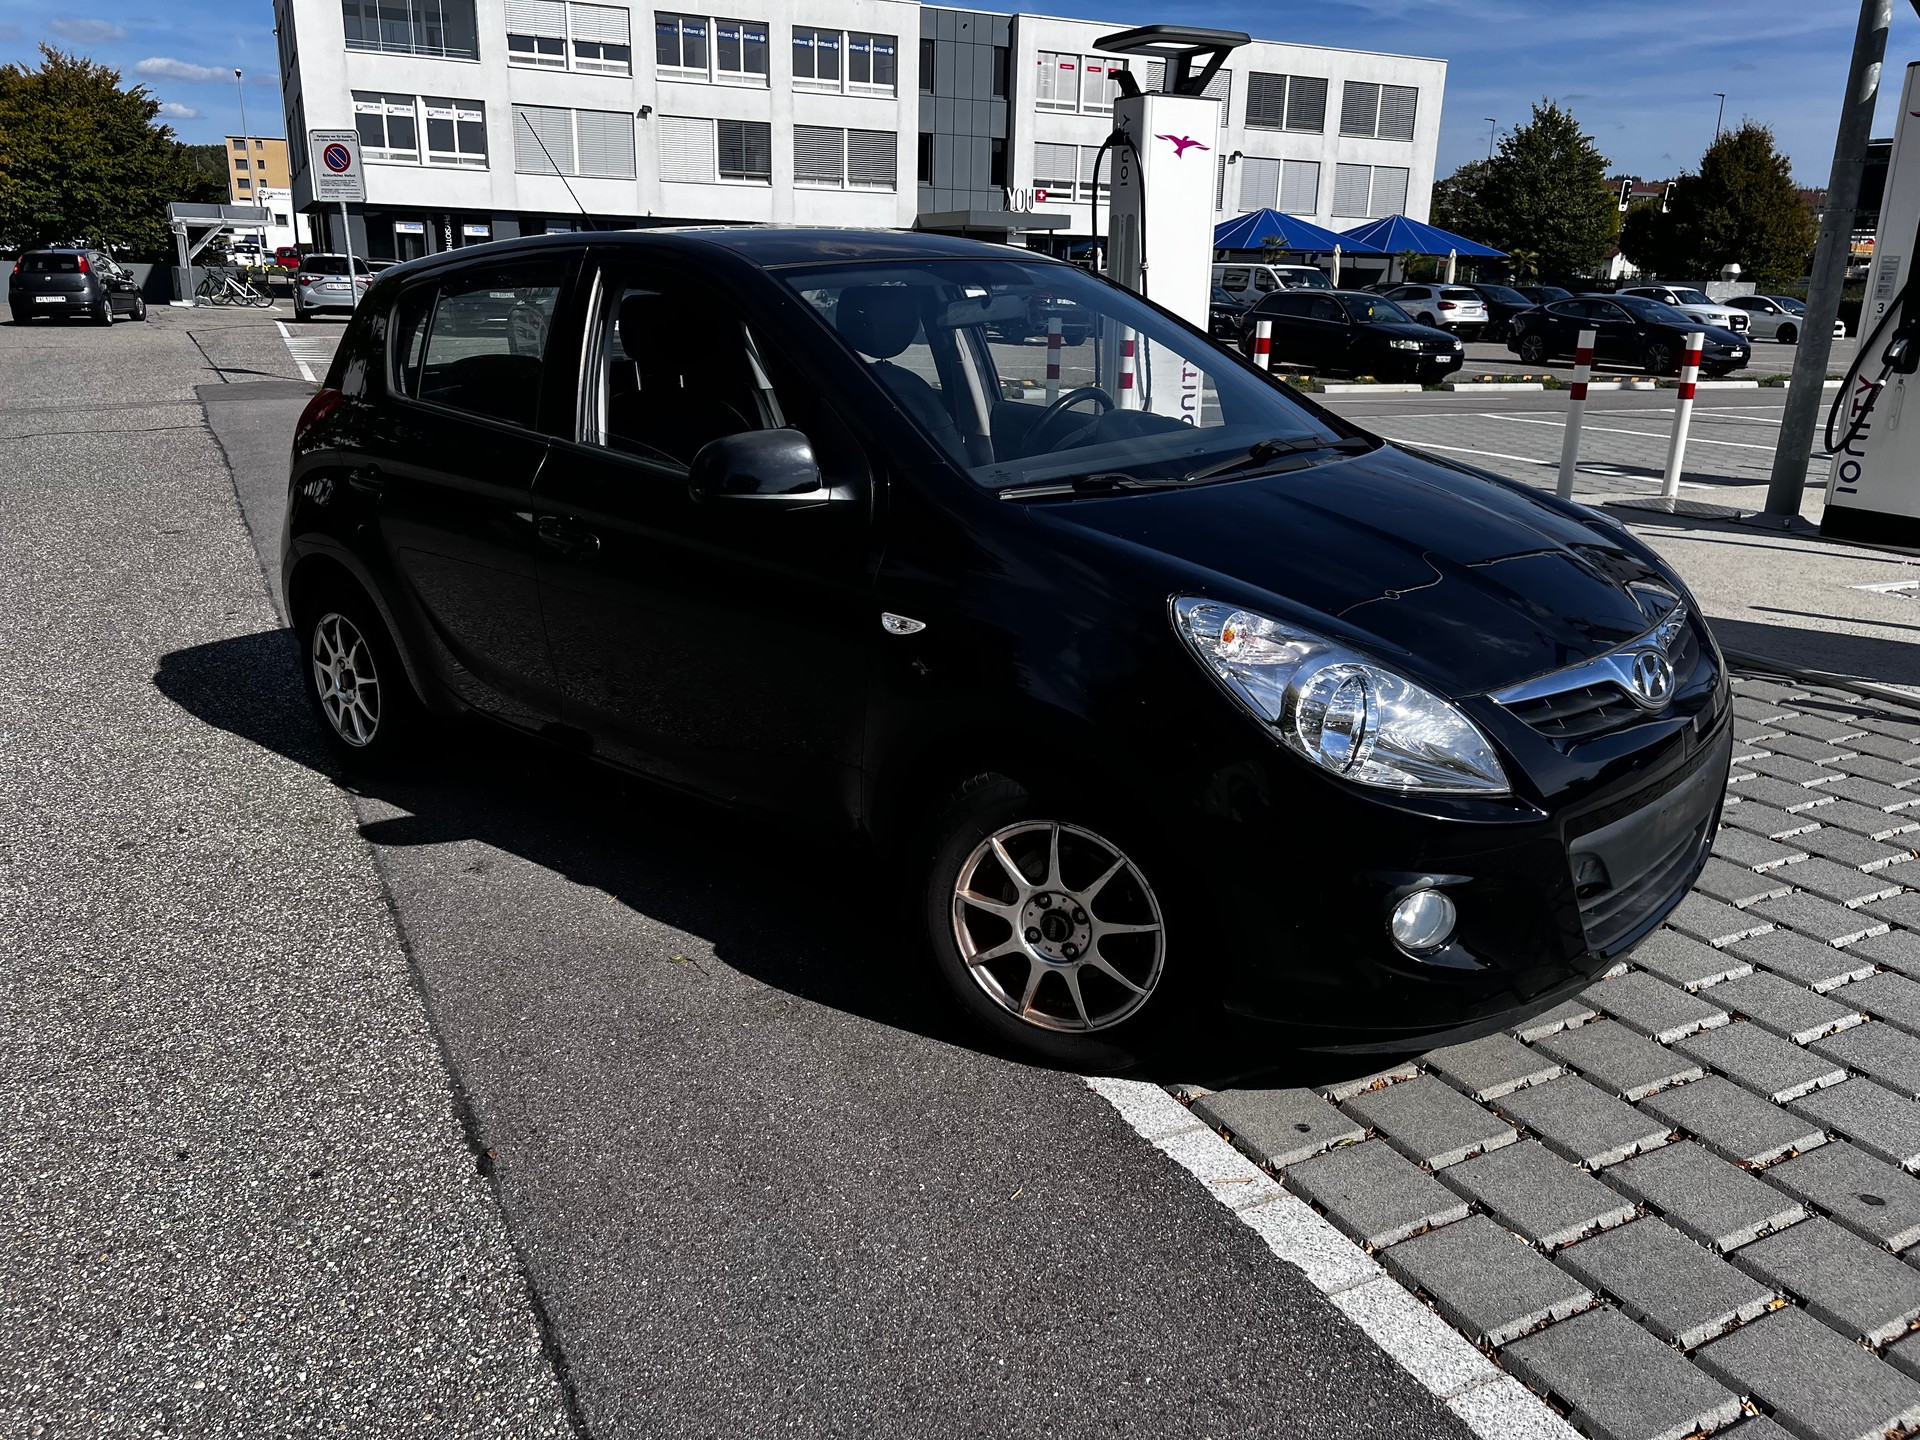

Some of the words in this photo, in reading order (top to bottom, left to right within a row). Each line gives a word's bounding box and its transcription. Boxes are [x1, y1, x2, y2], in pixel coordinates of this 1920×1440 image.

[1120, 114, 1130, 186] IONTY
[1006, 187, 1034, 213] YOU
[1877, 303, 1884, 313] 3
[1836, 374, 1876, 494] IONITY
